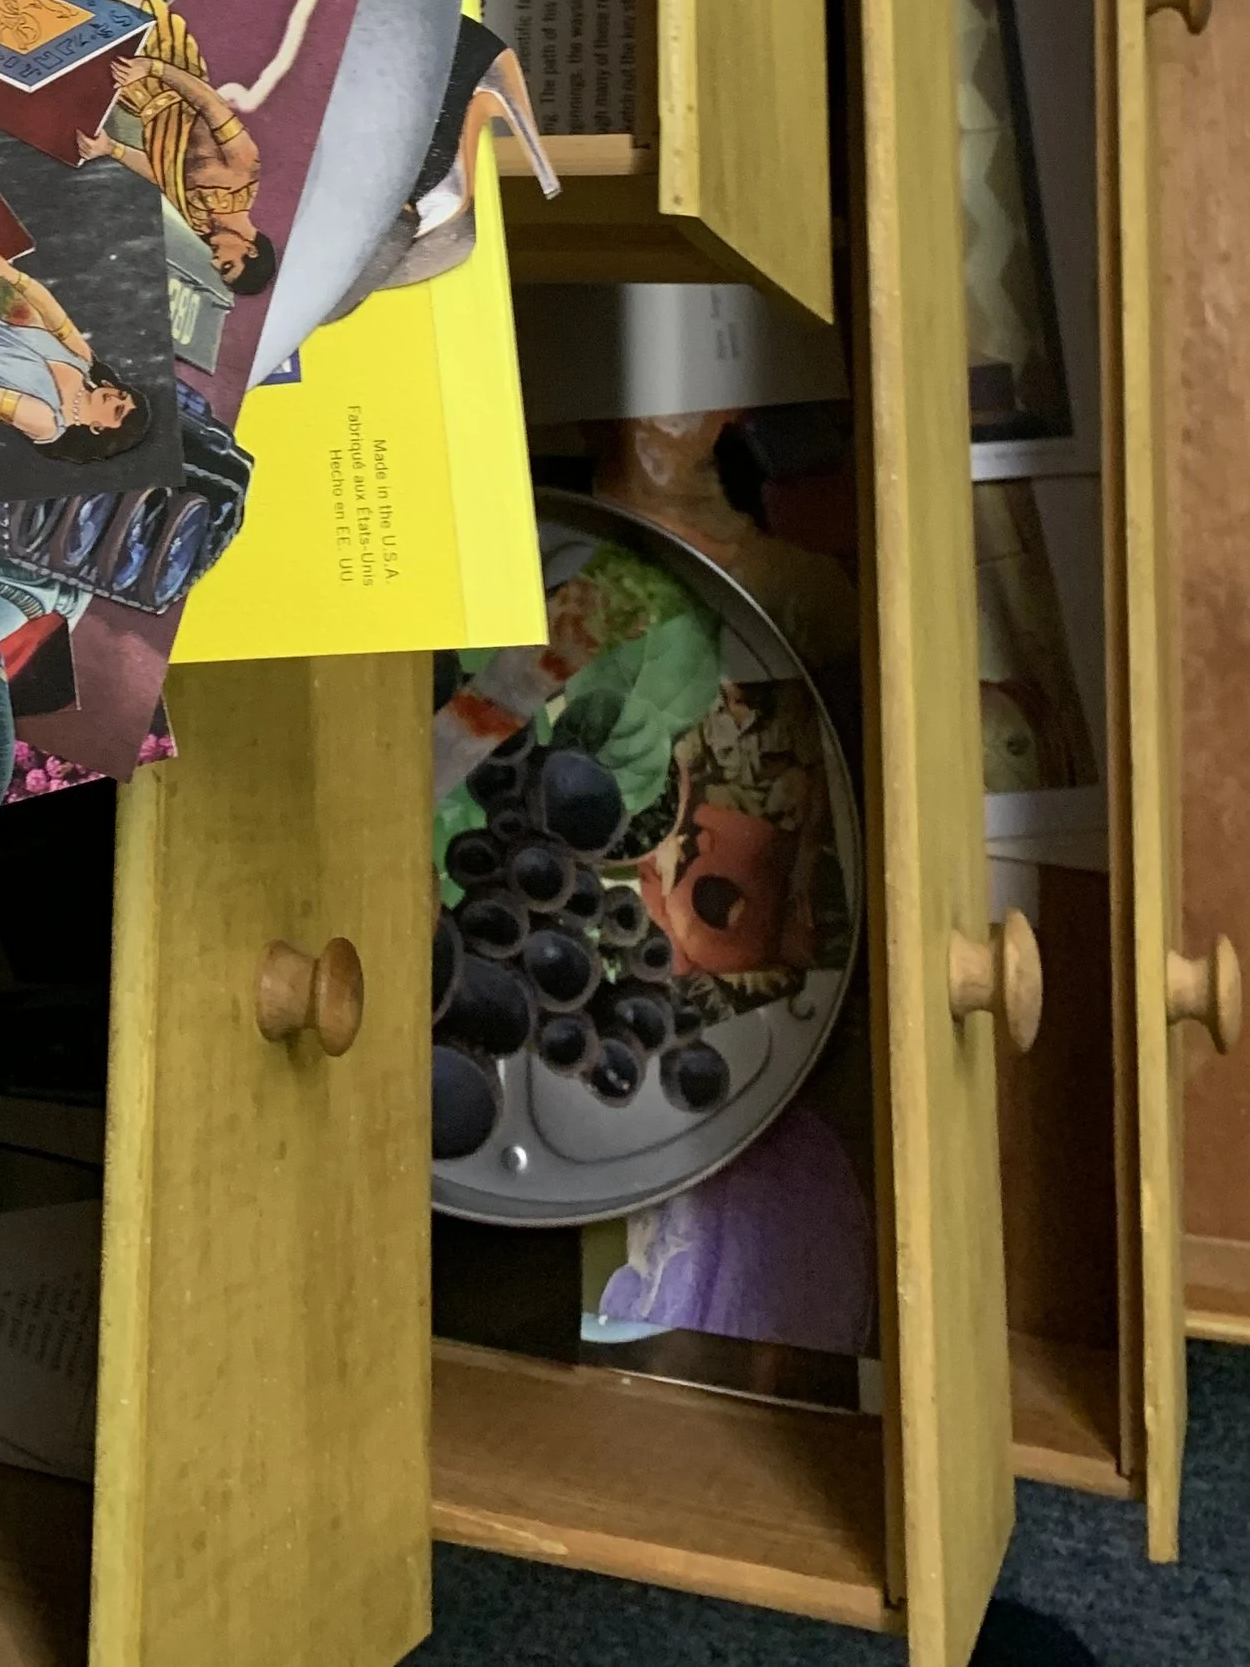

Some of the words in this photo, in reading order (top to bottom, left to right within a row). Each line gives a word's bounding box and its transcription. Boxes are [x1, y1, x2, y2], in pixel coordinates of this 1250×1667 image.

[541, 27, 557, 41] of
[542, 44, 559, 75] path
[566, 42, 582, 63] the
[540, 80, 556, 105] The
[346, 405, 366, 470] Fabriqué
[372, 439, 390, 480] Made
[328, 449, 347, 497] Hecho
[353, 475, 368, 501] aux
[376, 485, 390, 499] in
[333, 502, 348, 520] en
[378, 504, 393, 529] the
[336, 526, 351, 550] EE.
[355, 506, 376, 587] États-Unis
[381, 535, 399, 585] U.S.A.
